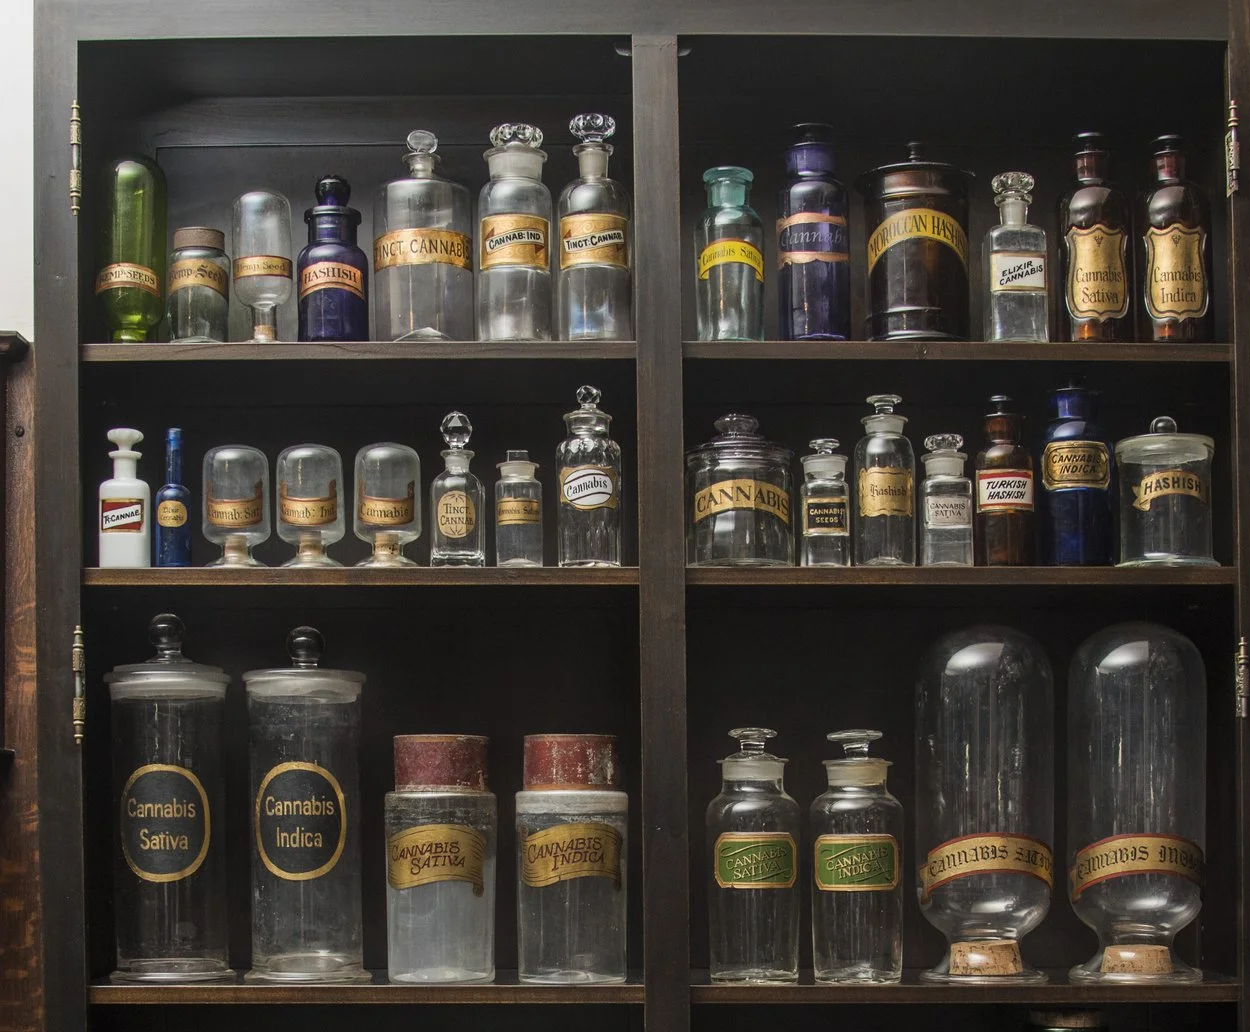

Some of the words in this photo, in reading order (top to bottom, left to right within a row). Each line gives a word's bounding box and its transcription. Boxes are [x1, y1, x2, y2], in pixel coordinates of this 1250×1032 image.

[870, 214, 928, 258] MOROCCAN
[409, 239, 472, 260] CANNABIS
[702, 247, 736, 264] Cannabis
[303, 267, 358, 283] HASHISH
[999, 265, 1044, 287] CANNABIS
[1001, 261, 1033, 277] ELIXIR
[1076, 267, 1122, 283] Cannabis
[1153, 267, 1202, 283] Cannabis
[1082, 287, 1120, 304] Sativa
[1161, 287, 1197, 303] Indica
[1051, 454, 1101, 465] CANNABIS
[1059, 465, 1097, 475] INDICA
[566, 477, 609, 498] Cannabis
[869, 483, 907, 499] Hashish
[986, 480, 1026, 491] TURKISH
[1143, 478, 1202, 496] HASHISH
[697, 485, 789, 516] CANNABIS
[987, 491, 1026, 501] HASHISH
[360, 504, 410, 518] Cannabis
[809, 507, 845, 516] CANNABIS
[929, 502, 966, 510] CANNABIS
[935, 509, 962, 517] SATIVA
[815, 516, 839, 524] SEEDS
[127, 797, 197, 819] Cannabis
[265, 796, 336, 817] Cannabis
[139, 828, 189, 850] Sativa
[276, 827, 323, 848] Indica
[391, 840, 461, 862] CANNABIS
[527, 837, 602, 864] CANNABIS
[726, 845, 788, 871] CANNABIS
[826, 845, 888, 872] CANNABIS
[410, 854, 465, 875] SATIVA
[551, 852, 604, 871] INDICA
[733, 859, 782, 880] SATIVA
[838, 859, 883, 880] INDICA
[929, 844, 1008, 877] CANNABIS
[1077, 845, 1149, 880] CANNABIS
